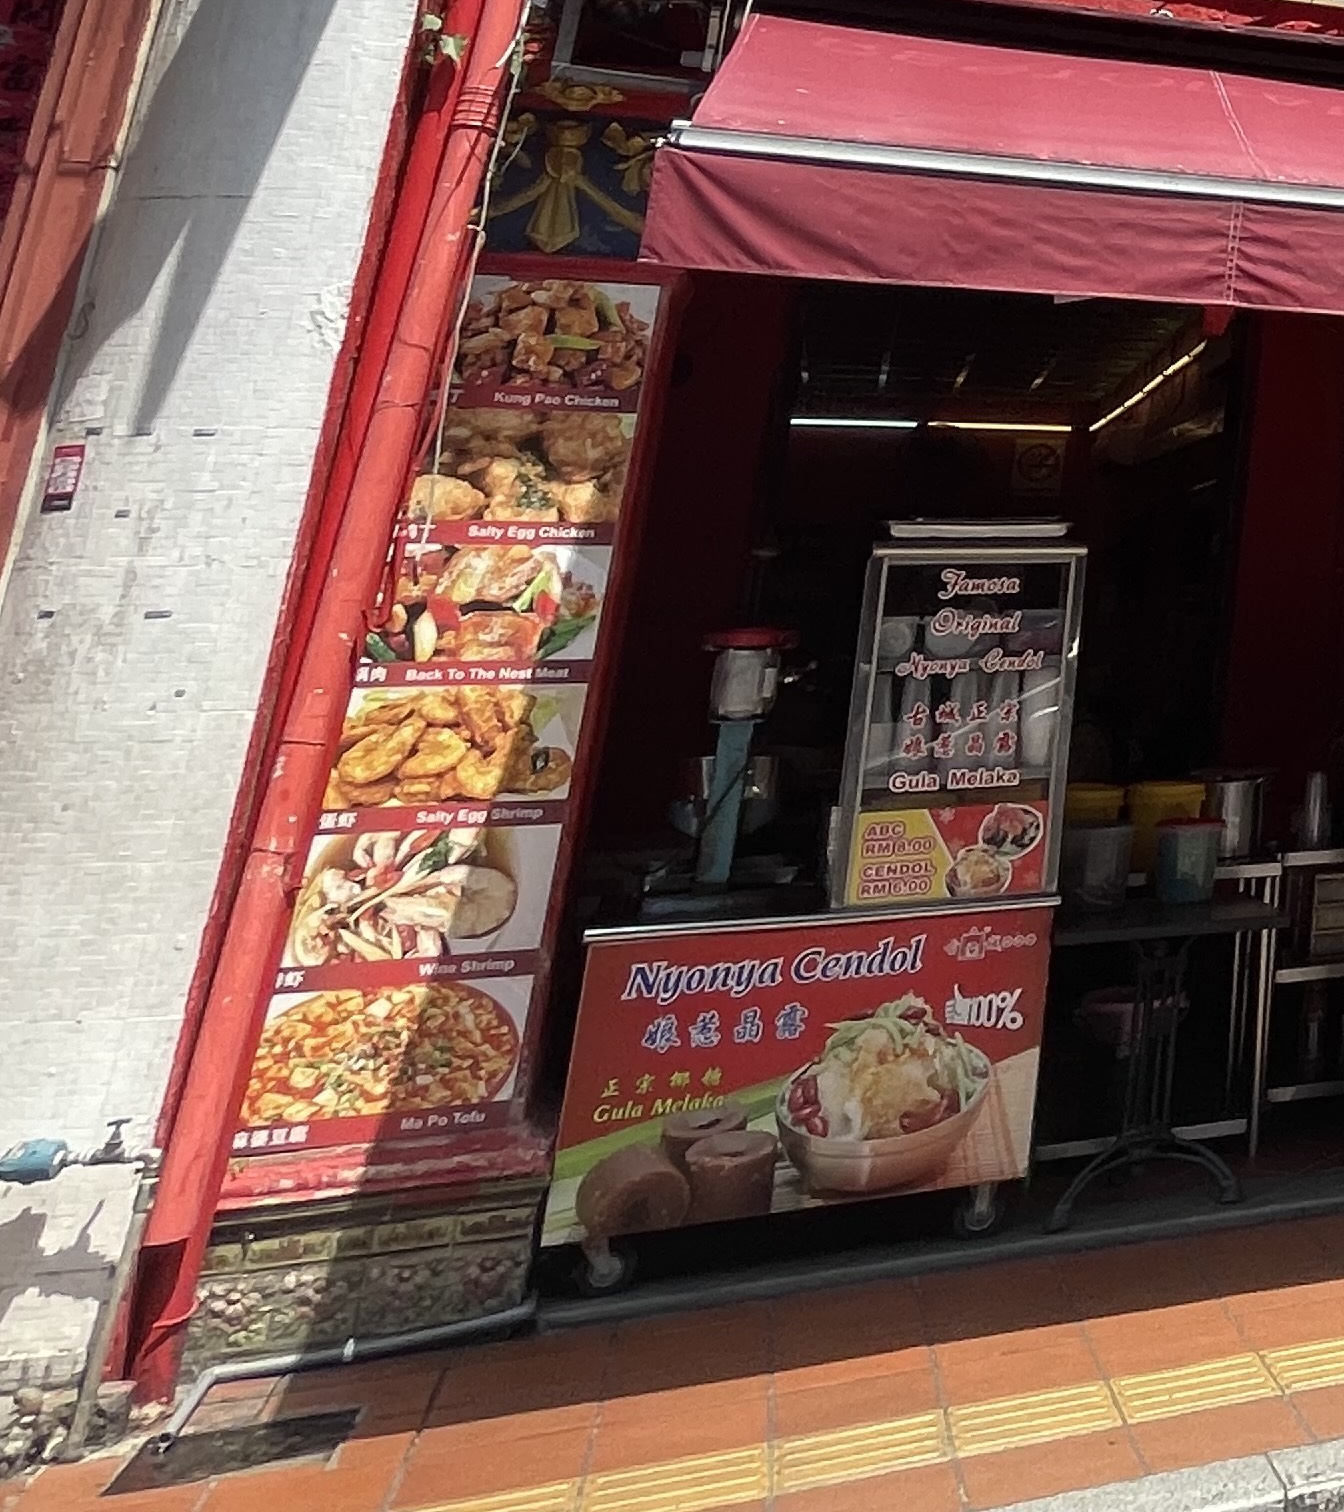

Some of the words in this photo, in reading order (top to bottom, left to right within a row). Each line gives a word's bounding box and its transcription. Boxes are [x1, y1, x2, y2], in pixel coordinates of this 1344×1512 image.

[493, 391, 533, 408] Kung
[564, 393, 620, 408] Chicken
[507, 525, 536, 541] Egg
[538, 524, 596, 539] Chicken
[938, 569, 1020, 600] Famosa
[931, 607, 1020, 640] Original
[405, 668, 443, 682] Back
[447, 668, 465, 681] To
[469, 667, 495, 681] The
[498, 666, 533, 680] Nest
[888, 772, 939, 793] Gula
[947, 767, 1021, 790] Melaka
[457, 806, 489, 824] Egg
[861, 861, 936, 879] CENDOL
[621, 956, 783, 1006] Nyonya
[790, 934, 927, 987] Cendol
[967, 987, 1024, 1030] 100%
[592, 1100, 644, 1124] Gula
[650, 1090, 726, 1118] Melaka
